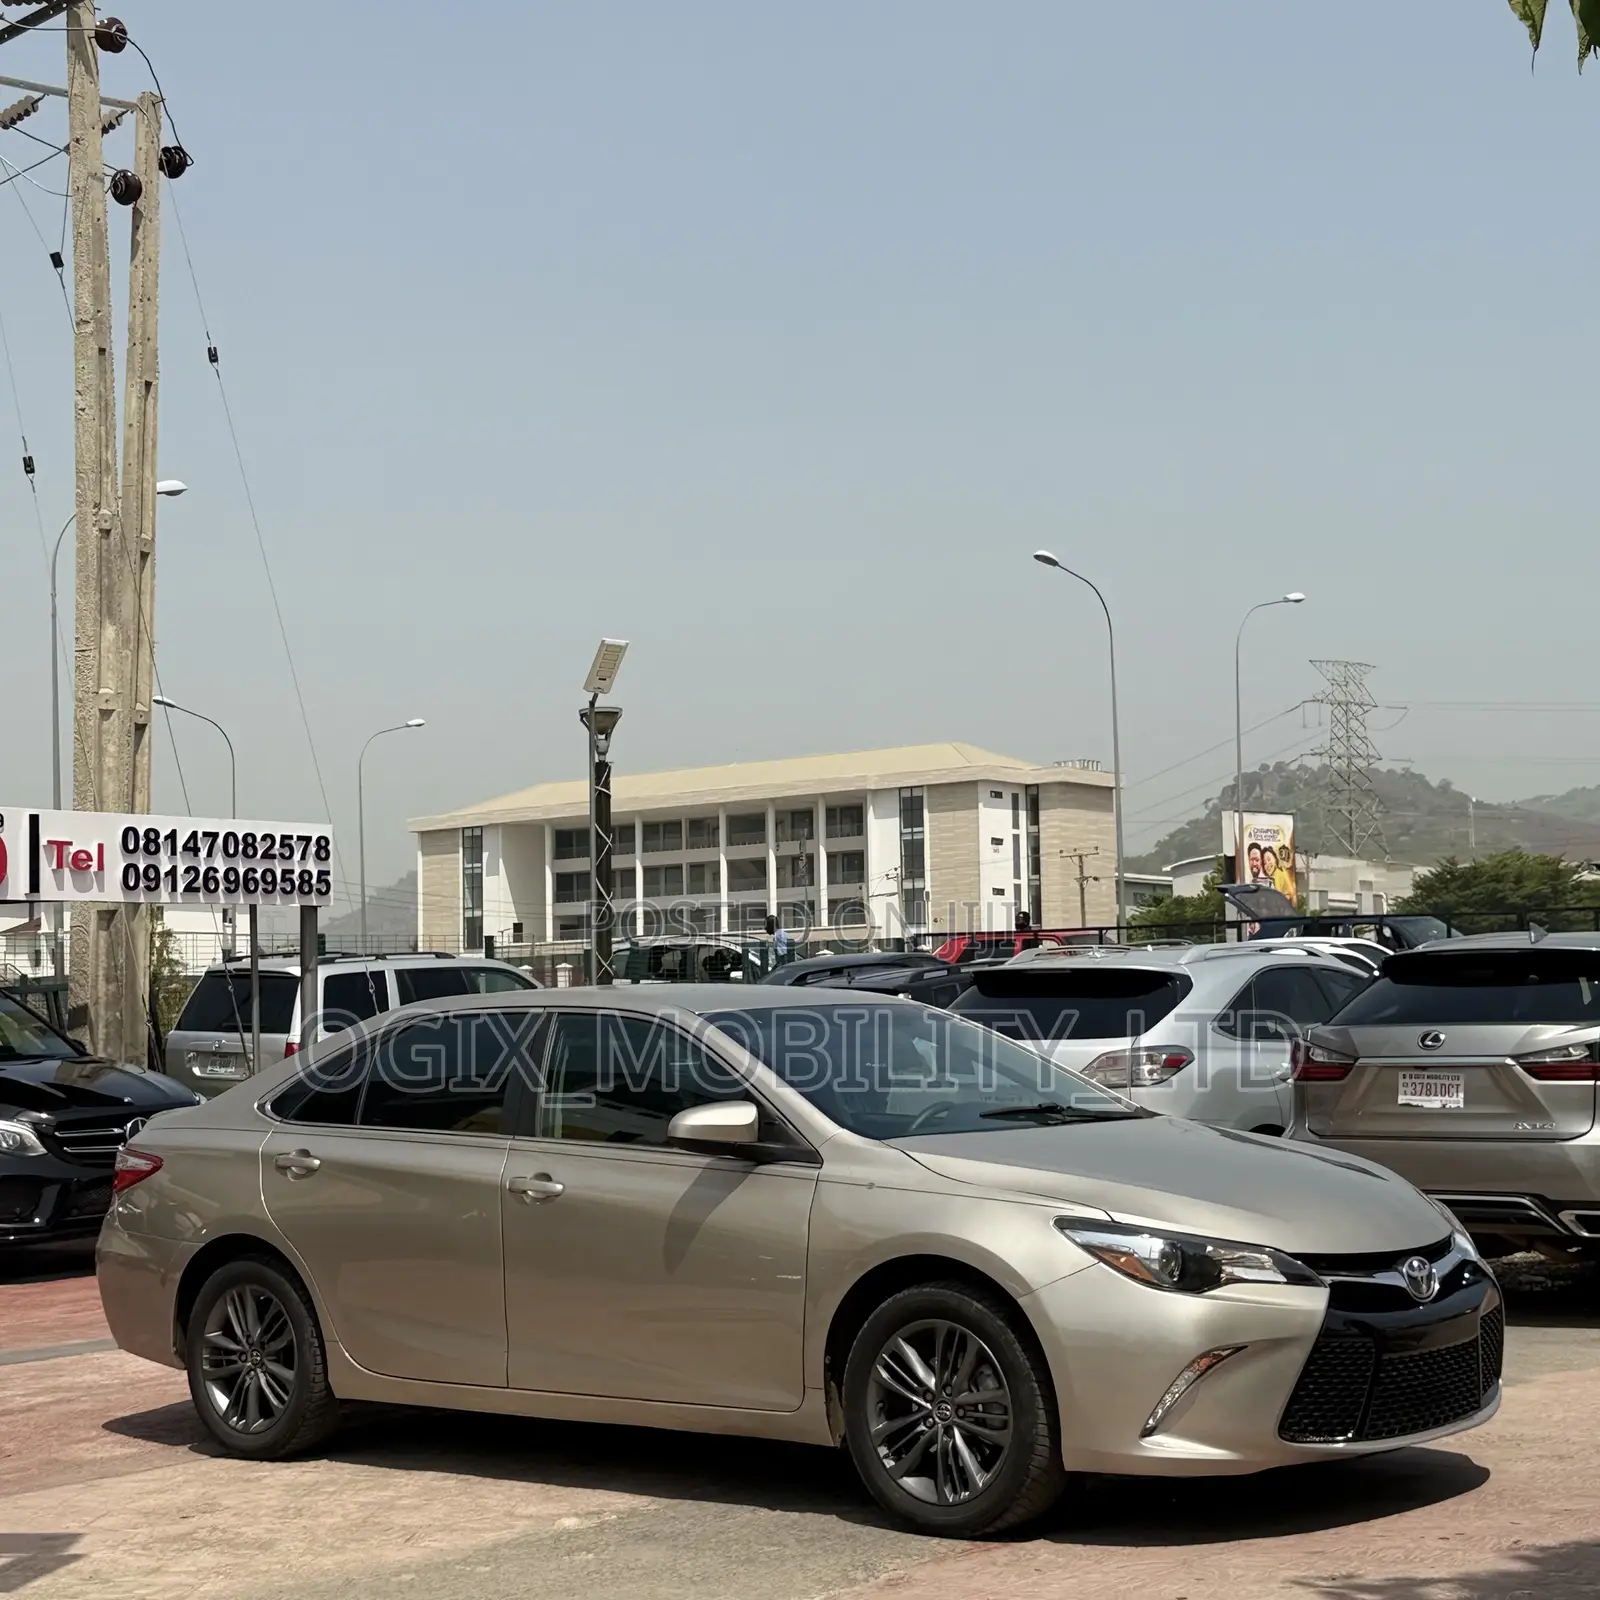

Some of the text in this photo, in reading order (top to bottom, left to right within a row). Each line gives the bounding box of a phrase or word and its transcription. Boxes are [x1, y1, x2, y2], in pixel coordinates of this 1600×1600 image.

[46, 839, 105, 872] Tel
[121, 825, 331, 862] 08147082578
[121, 863, 331, 896] 09126969585
